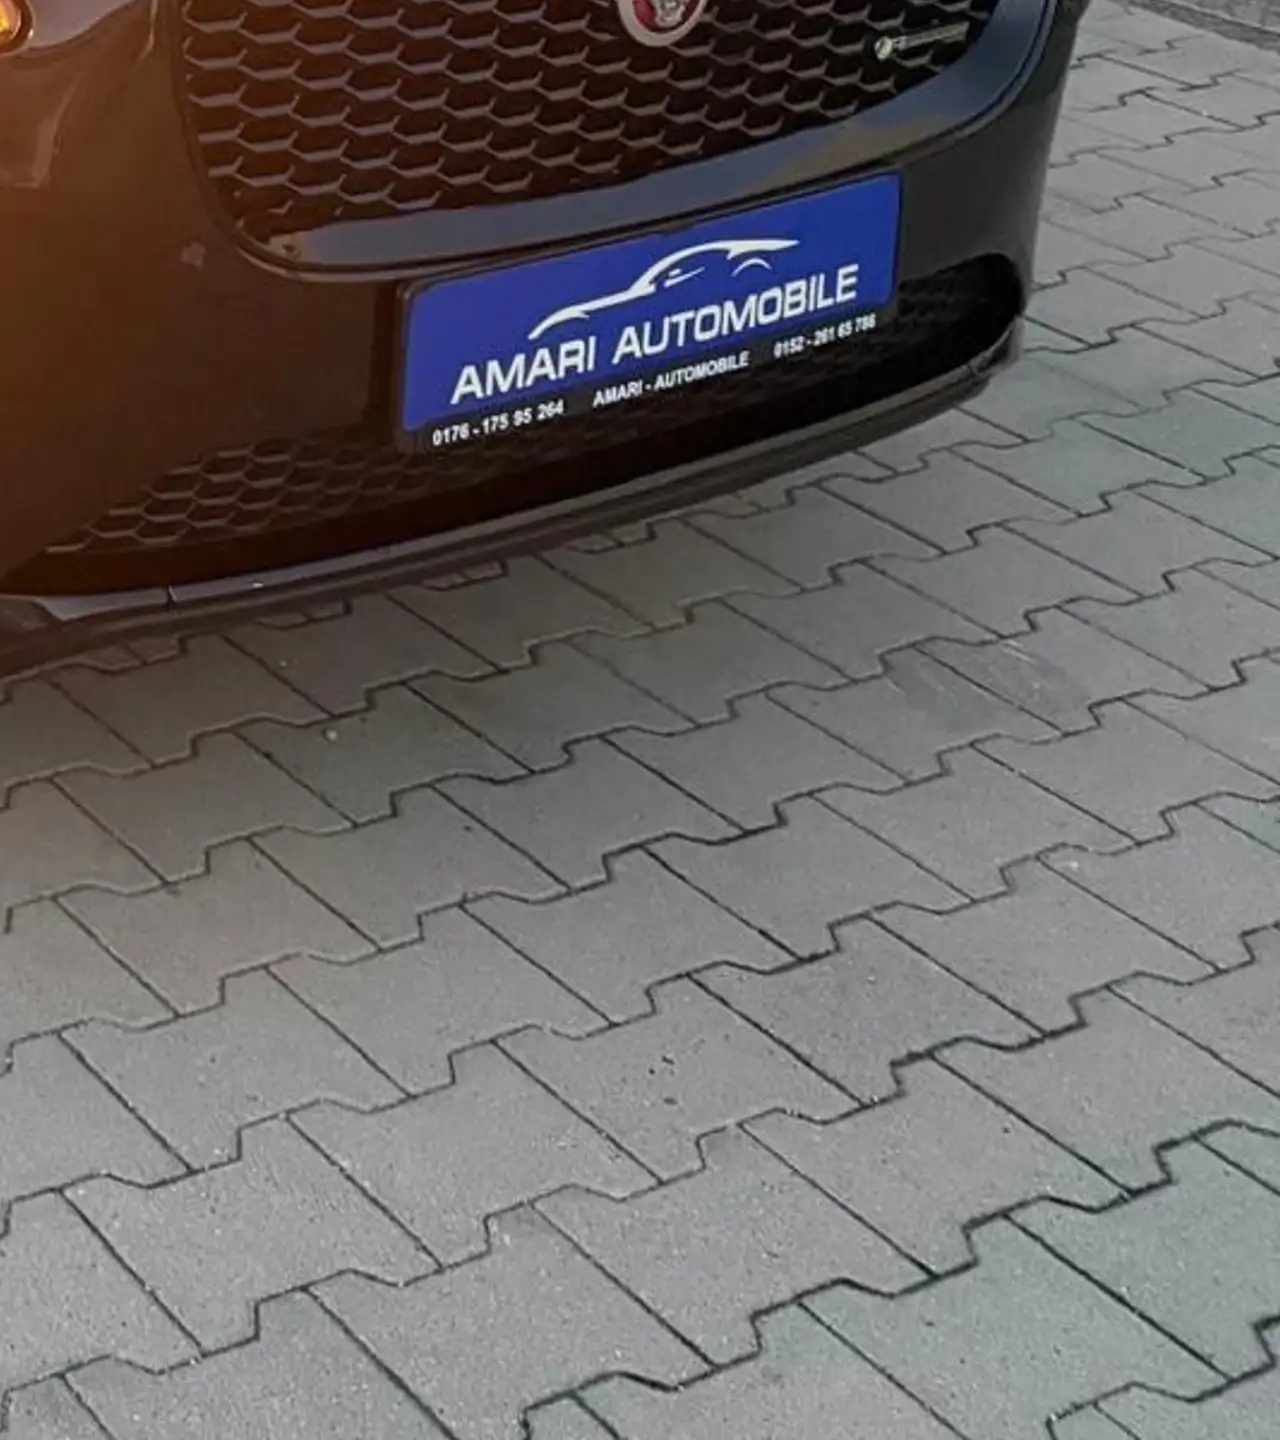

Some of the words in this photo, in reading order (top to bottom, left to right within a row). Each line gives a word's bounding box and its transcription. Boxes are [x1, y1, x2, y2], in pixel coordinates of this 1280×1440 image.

[450, 337, 596, 405] AMARI
[612, 264, 859, 366] AUTOMOBILE
[592, 379, 643, 409] AMARI
[654, 350, 751, 392] AUTOMOBILE
[481, 412, 509, 435] 175
